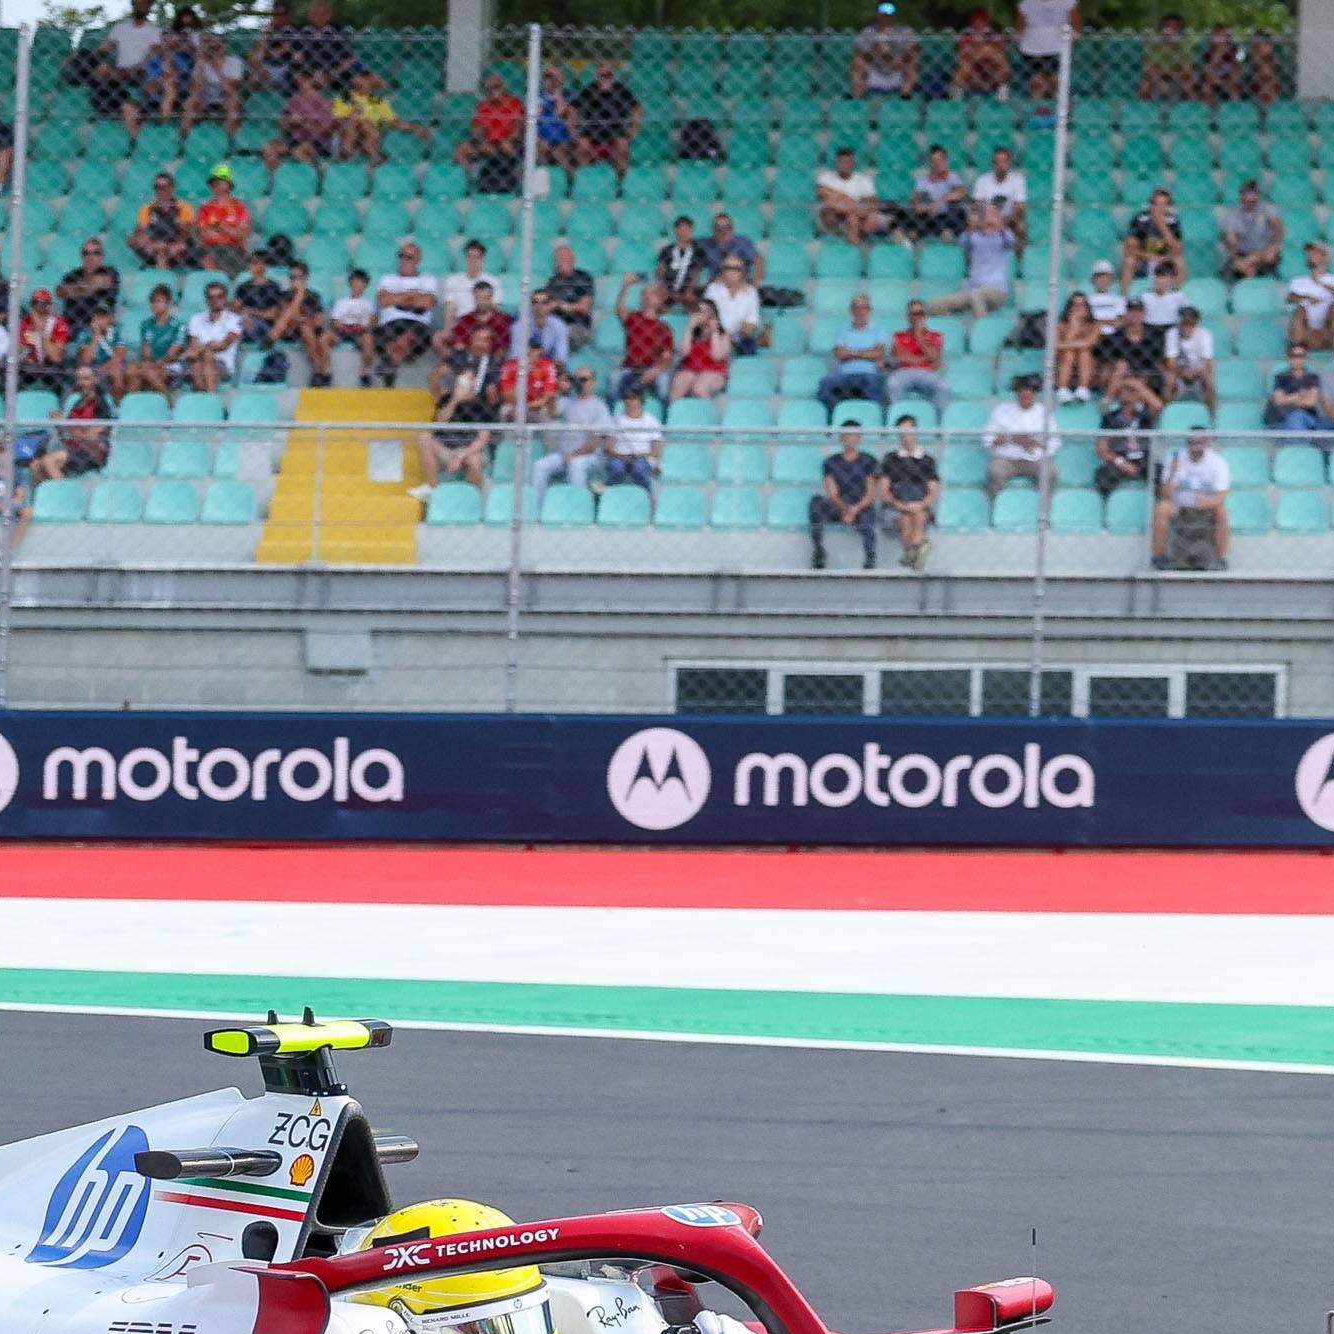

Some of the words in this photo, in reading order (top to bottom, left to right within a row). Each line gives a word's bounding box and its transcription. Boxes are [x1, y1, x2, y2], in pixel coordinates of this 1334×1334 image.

[44, 736, 404, 802] motorola
[735, 742, 1094, 808] motorola
[268, 1112, 332, 1152] ZCG
[436, 1227, 560, 1258] TECHNOLOGY
